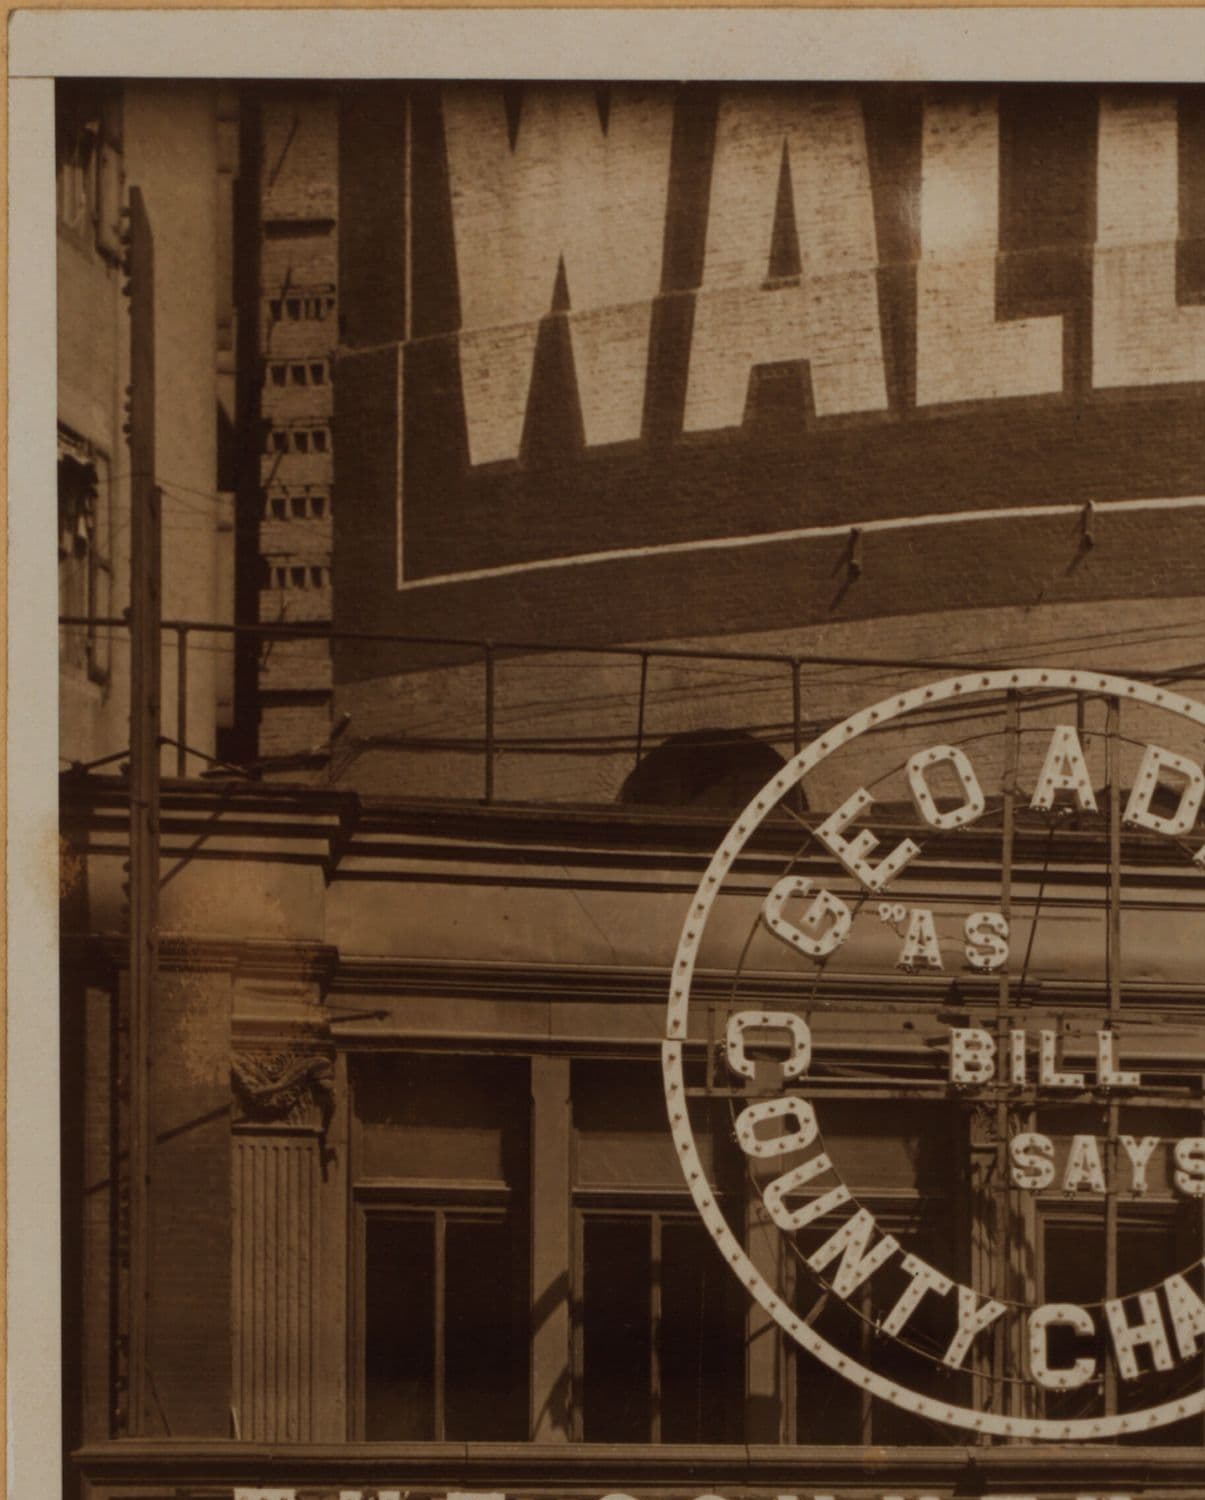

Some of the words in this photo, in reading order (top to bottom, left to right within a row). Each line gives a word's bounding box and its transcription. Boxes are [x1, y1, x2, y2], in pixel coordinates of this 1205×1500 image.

[762, 744, 985, 958] GEO
[949, 1027, 1141, 1087] BILL
[725, 1010, 1007, 1371] COUNTY
